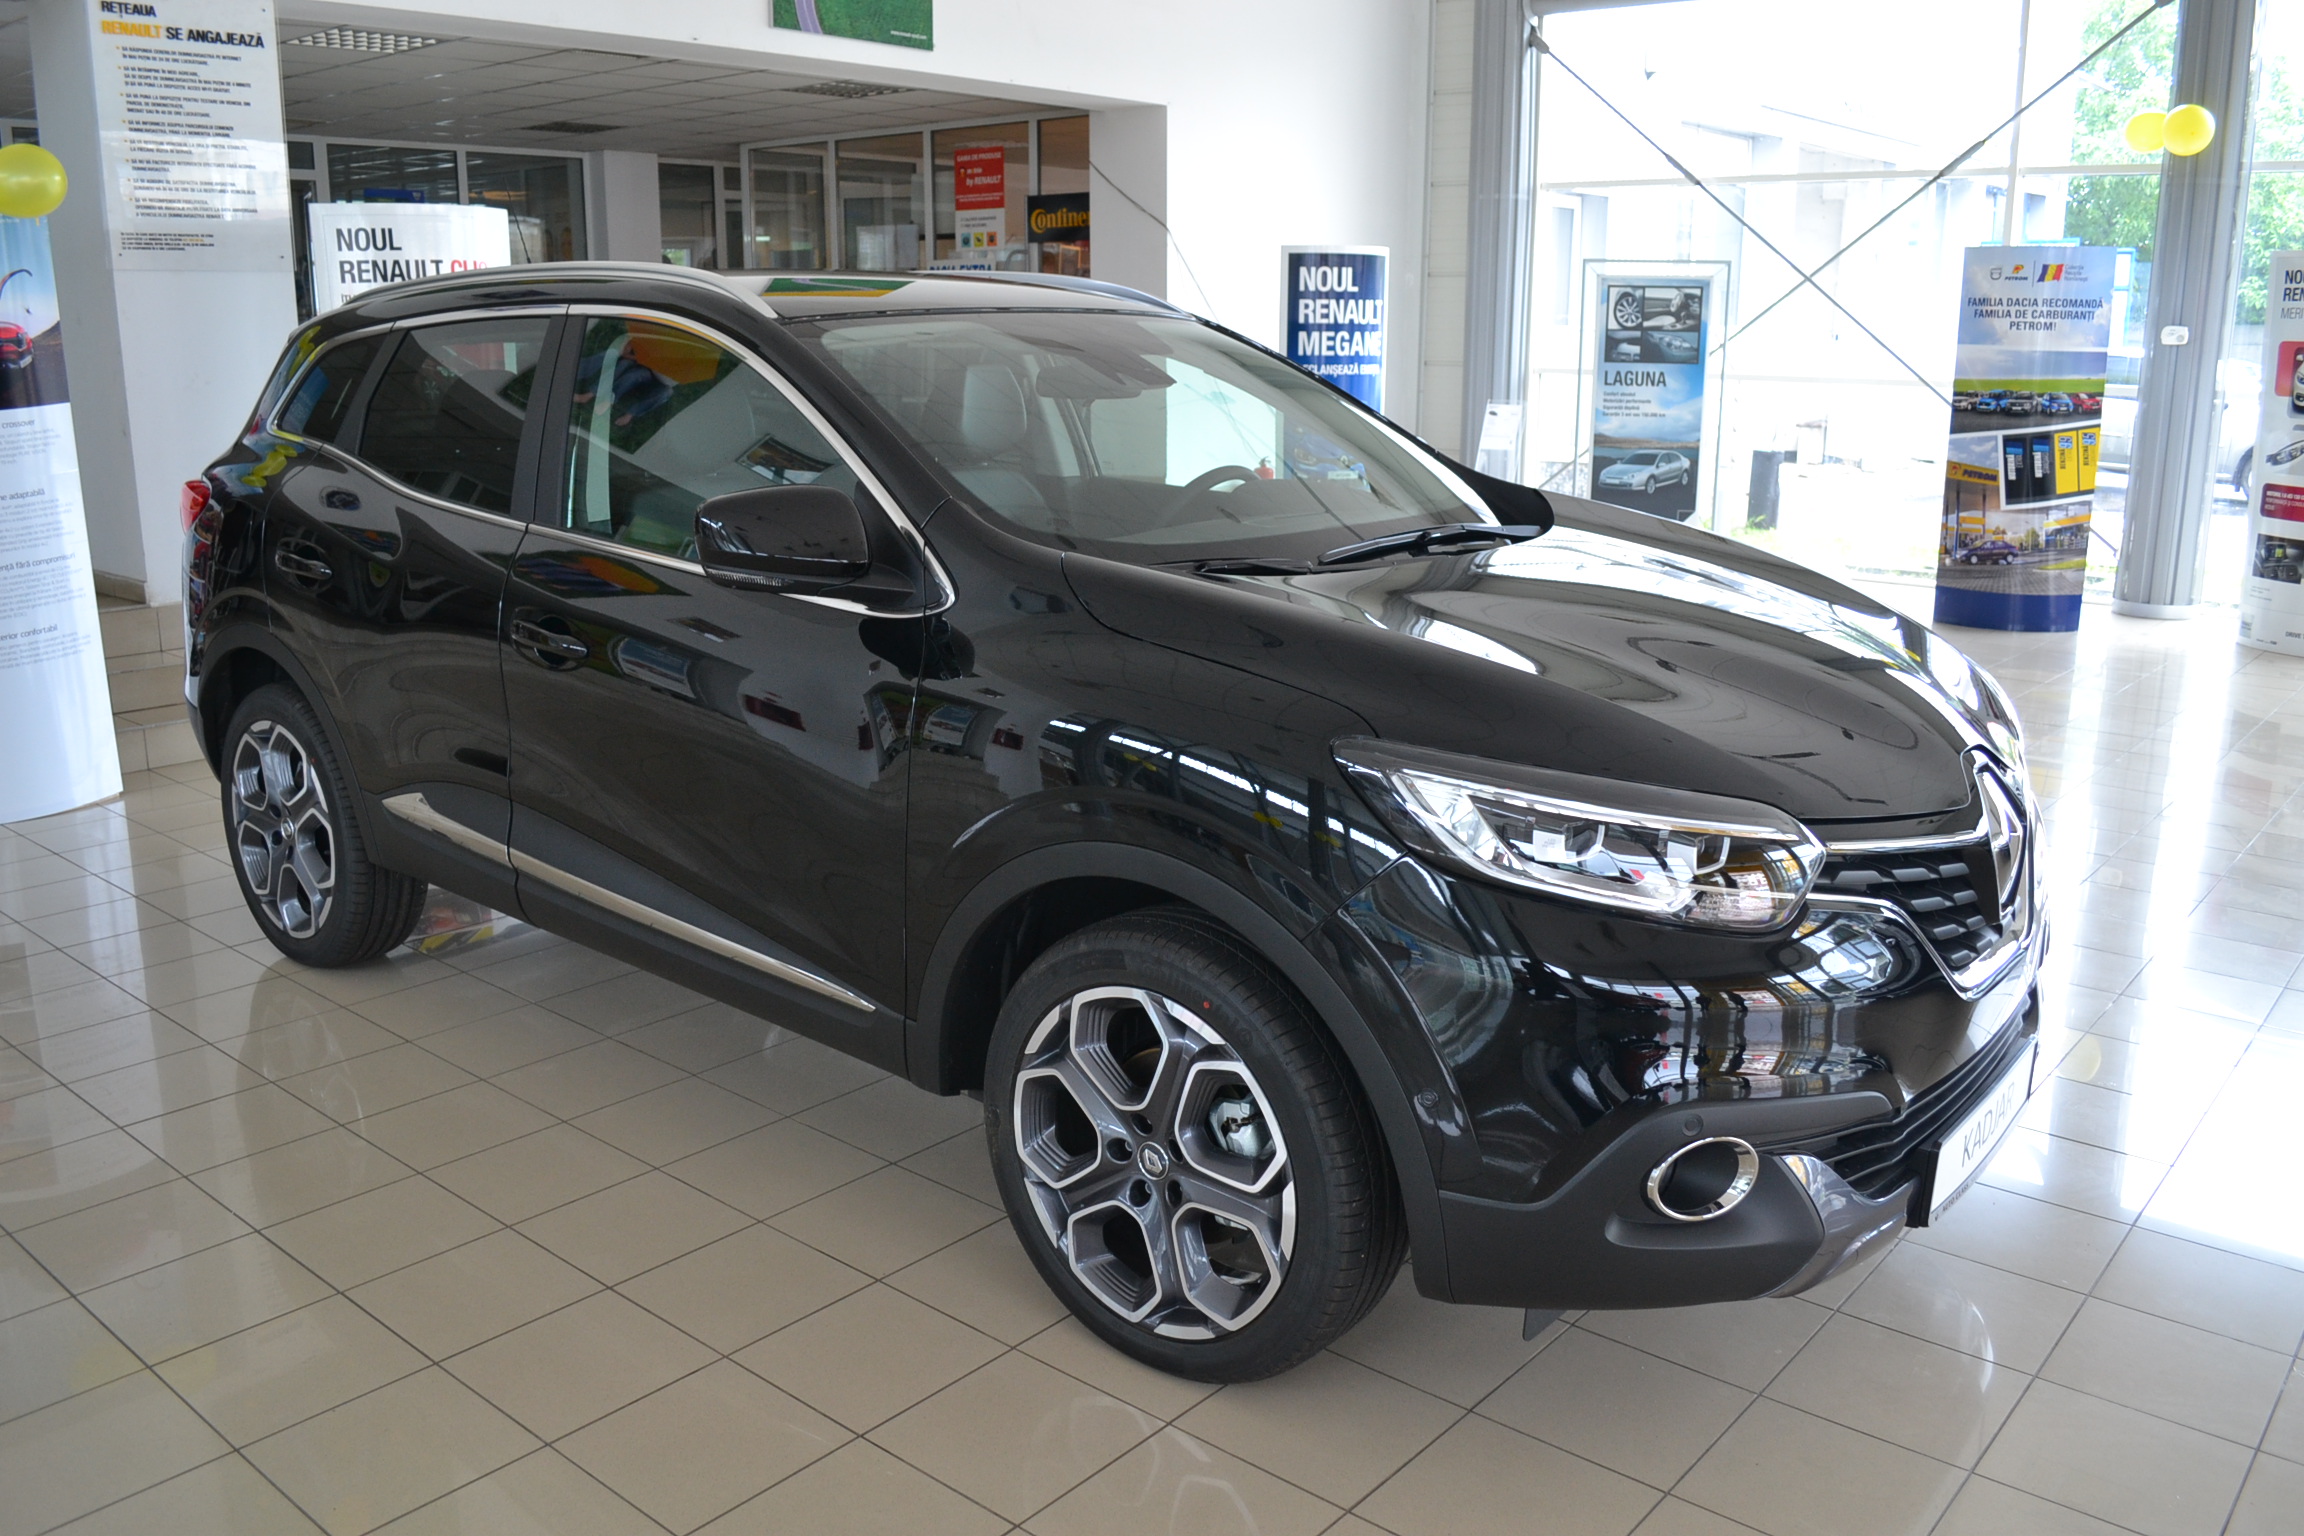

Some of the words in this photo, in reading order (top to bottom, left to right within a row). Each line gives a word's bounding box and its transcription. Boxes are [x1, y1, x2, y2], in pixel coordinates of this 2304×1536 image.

[101, 20, 162, 39] RENAULT
[166, 26, 184, 42] SE
[187, 28, 265, 48] ANGAJEAZĂ
[336, 228, 402, 252] NOUL
[339, 260, 444, 284] RENAULT
[1299, 266, 1359, 292] NOUL
[2285, 270, 2304, 284] NO
[1967, 297, 2003, 307] FAMILIA
[2006, 297, 2039, 307] DACIA
[2042, 297, 2103, 308] RECOMANDĂ
[1298, 299, 1383, 325] RENAULT
[1974, 309, 2011, 319] FAMILIA
[2015, 309, 2029, 319] DE
[2031, 310, 2094, 322] CARBURANȚI
[2280, 308, 2304, 319] MERI
[2009, 321, 2057, 331] PETROM!
[1298, 331, 1382, 357] MEGANE
[1604, 370, 1667, 387] LAGUNA
[2, 418, 36, 428] crossover
[0, 631, 19, 641] erior
[1961, 1081, 2015, 1168] KADJAR
